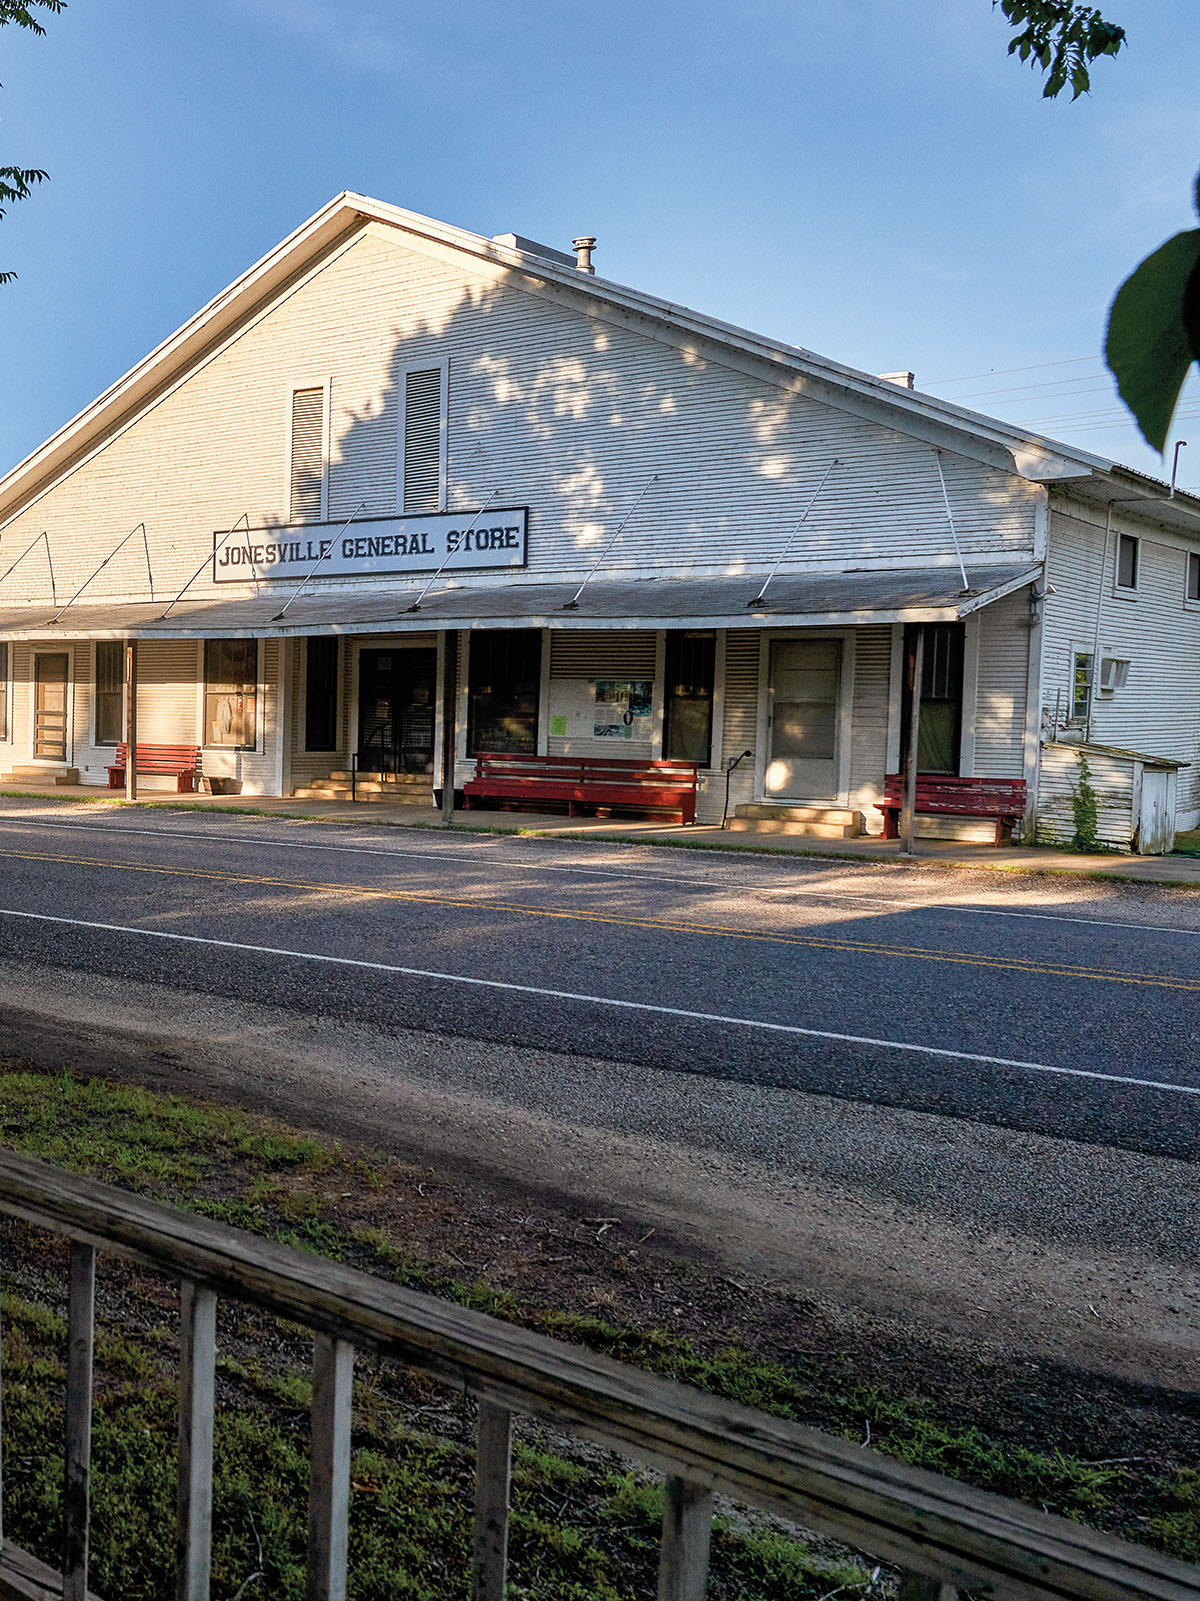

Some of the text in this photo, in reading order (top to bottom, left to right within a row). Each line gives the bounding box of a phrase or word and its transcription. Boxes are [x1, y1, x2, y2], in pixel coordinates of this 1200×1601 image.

[219, 527, 520, 567] JONESVILLE GENERAL STORE
